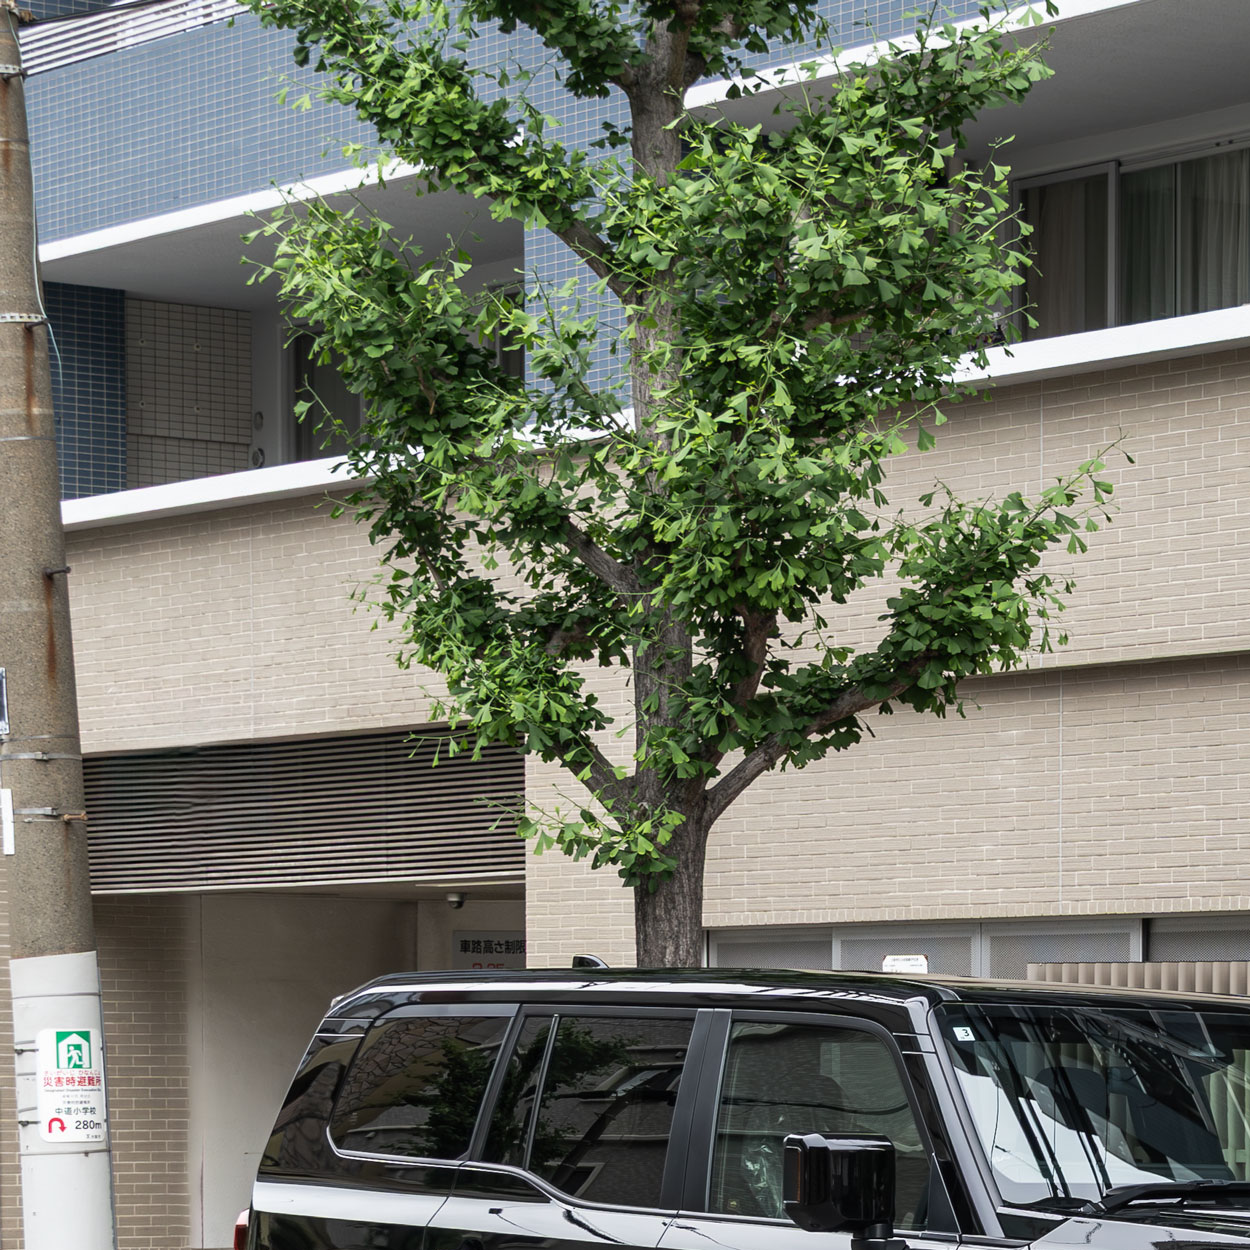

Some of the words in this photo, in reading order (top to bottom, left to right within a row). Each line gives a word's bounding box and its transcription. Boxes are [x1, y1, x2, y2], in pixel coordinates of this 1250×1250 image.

[460, 940, 526, 954] 車路高さ制限
[55, 1107, 96, 1115] 中道小学校
[75, 1120, 102, 1129] 280m
